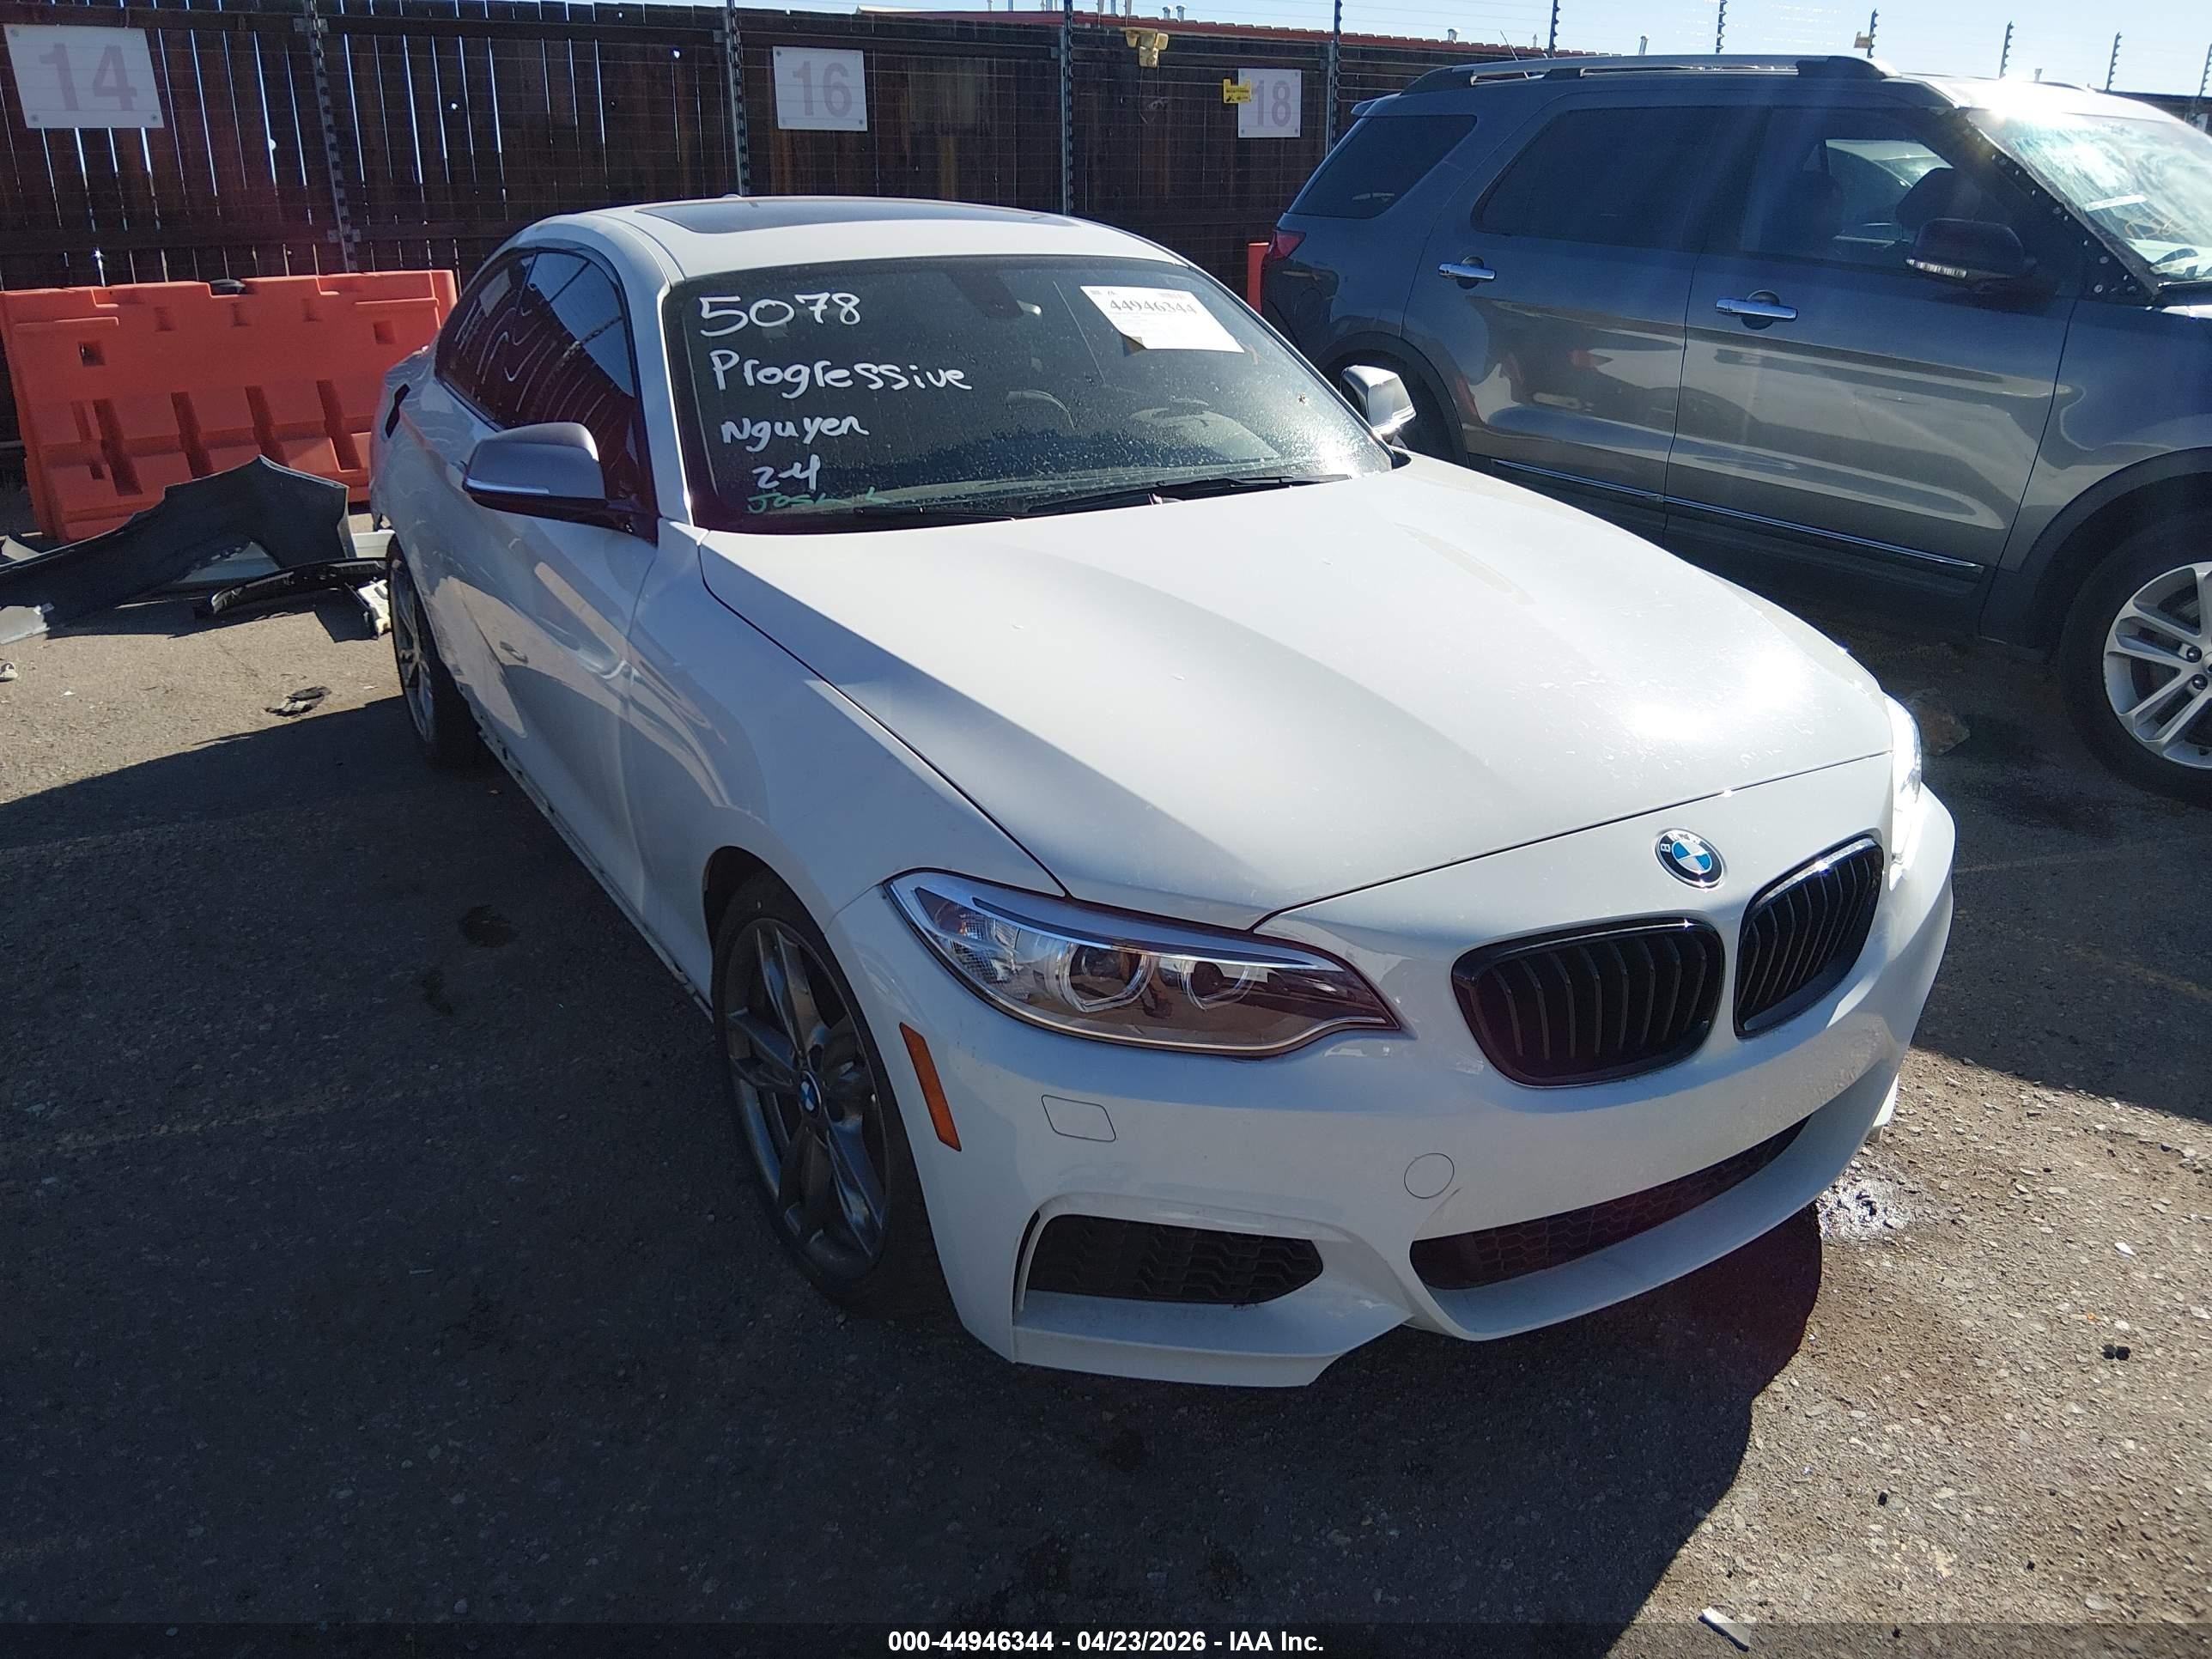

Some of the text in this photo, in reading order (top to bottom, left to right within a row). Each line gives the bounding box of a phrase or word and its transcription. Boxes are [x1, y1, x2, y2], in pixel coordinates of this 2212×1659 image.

[40, 43, 137, 111] 14
[793, 60, 853, 117] 16
[1253, 80, 1291, 127] 18
[700, 292, 861, 337] 5078
[709, 349, 973, 399] Progressive
[720, 416, 870, 453] Nguyen
